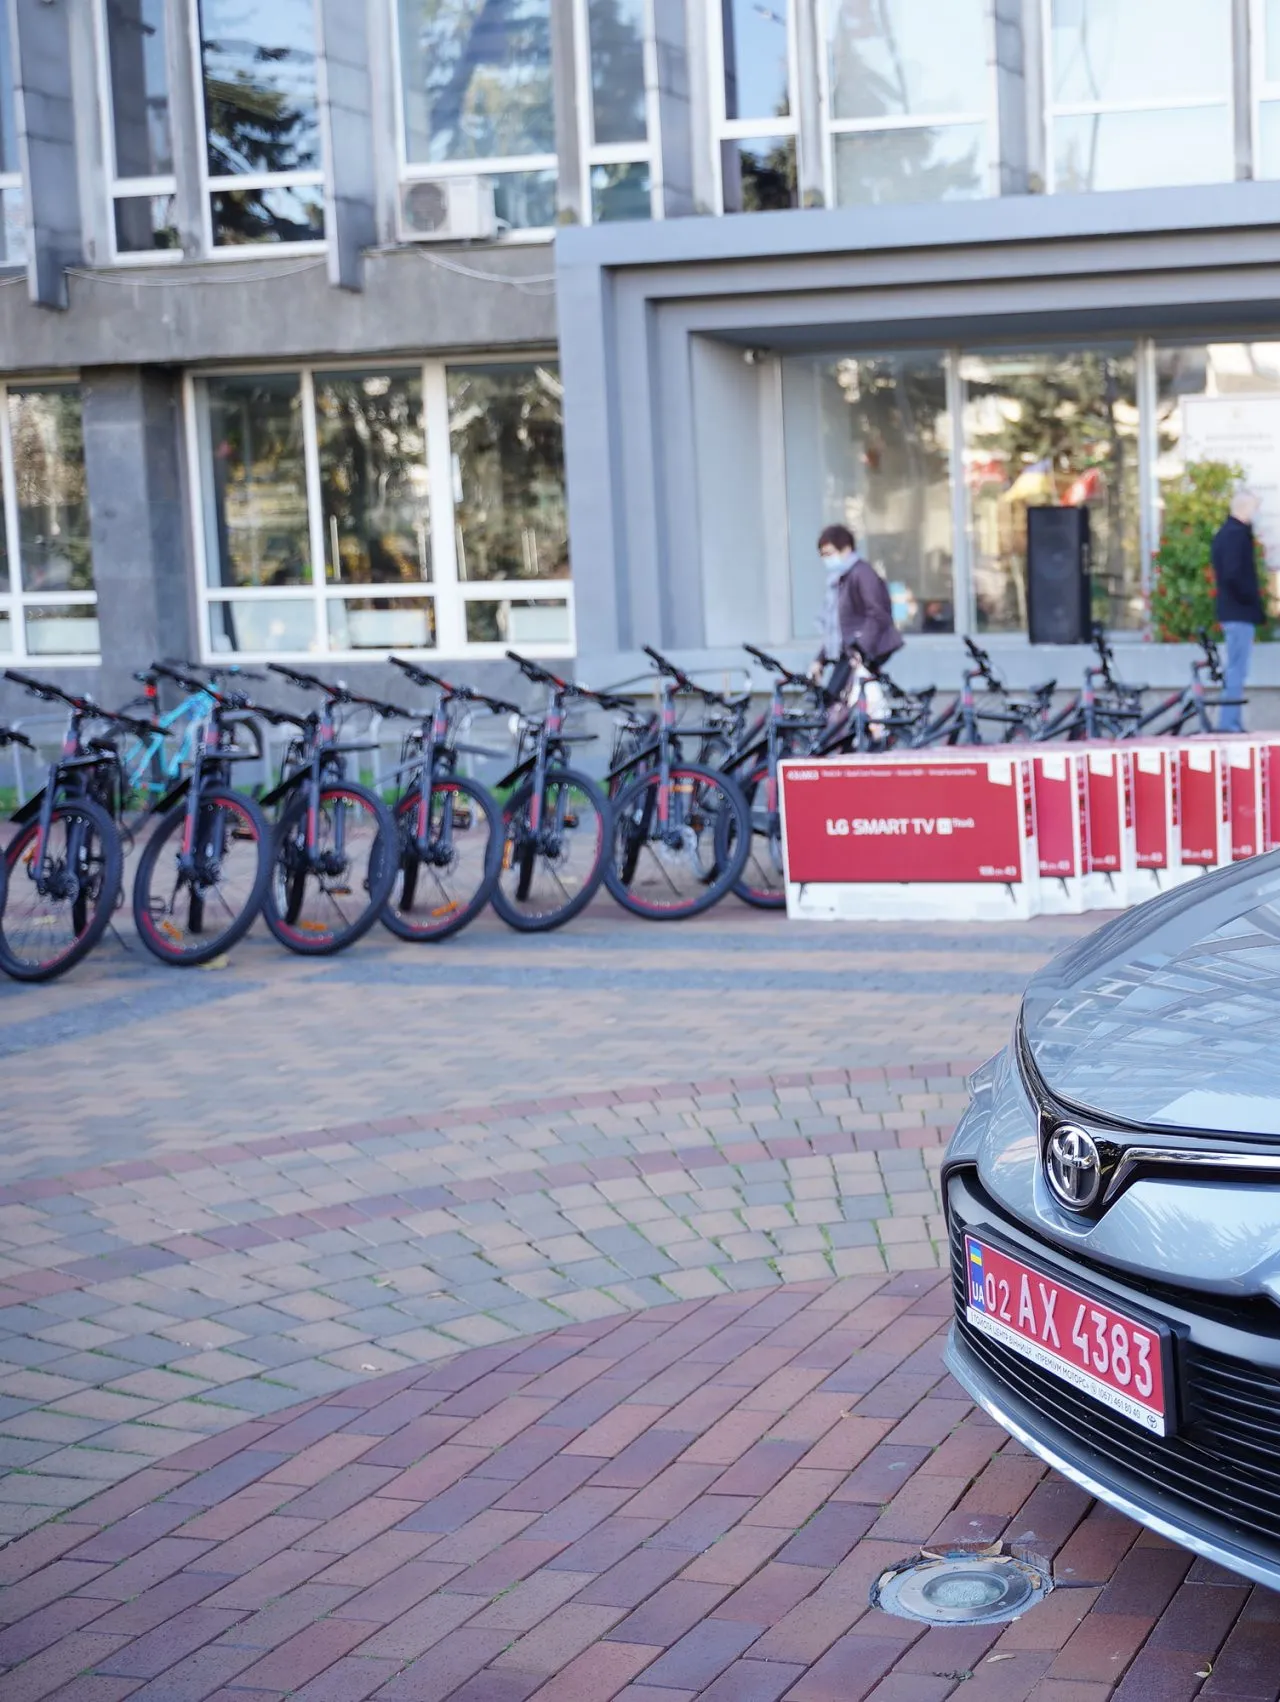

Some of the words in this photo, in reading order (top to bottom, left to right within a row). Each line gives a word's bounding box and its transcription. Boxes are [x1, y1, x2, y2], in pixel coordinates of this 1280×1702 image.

[826, 817, 849, 836] LG
[852, 817, 909, 836] SMART
[911, 817, 935, 835] TV
[972, 1282, 985, 1305] UA
[1071, 1304, 1154, 1398] 4383
